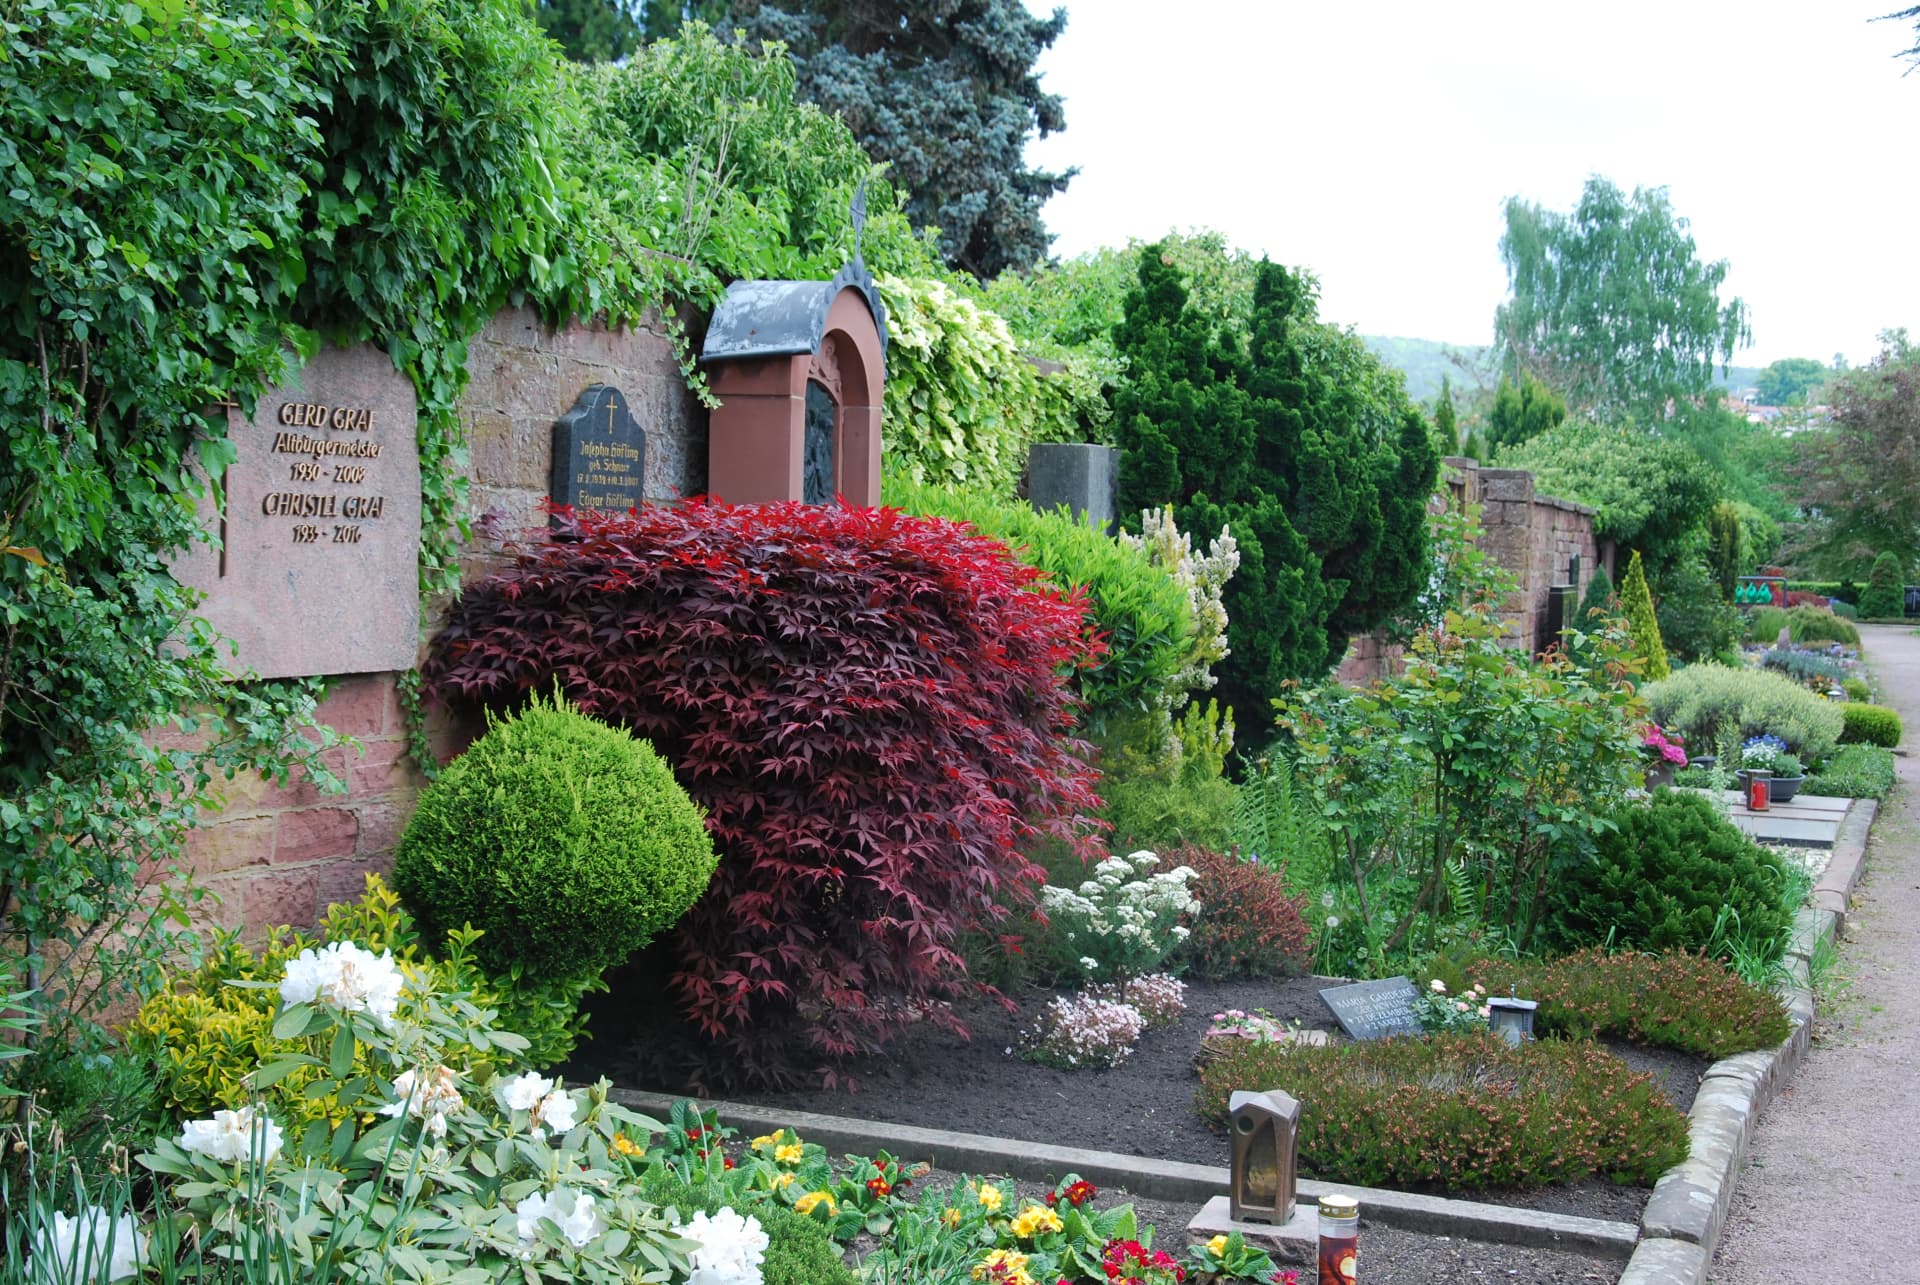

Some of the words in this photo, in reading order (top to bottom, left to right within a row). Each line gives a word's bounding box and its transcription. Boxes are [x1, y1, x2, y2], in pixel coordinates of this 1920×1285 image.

[279, 402, 328, 427] GERD
[330, 406, 379, 431] GRAF
[272, 431, 384, 460] Altbürgermeister
[291, 462, 321, 481] 1930
[262, 492, 341, 517] CHRISTEL
[343, 496, 391, 518] GRAF
